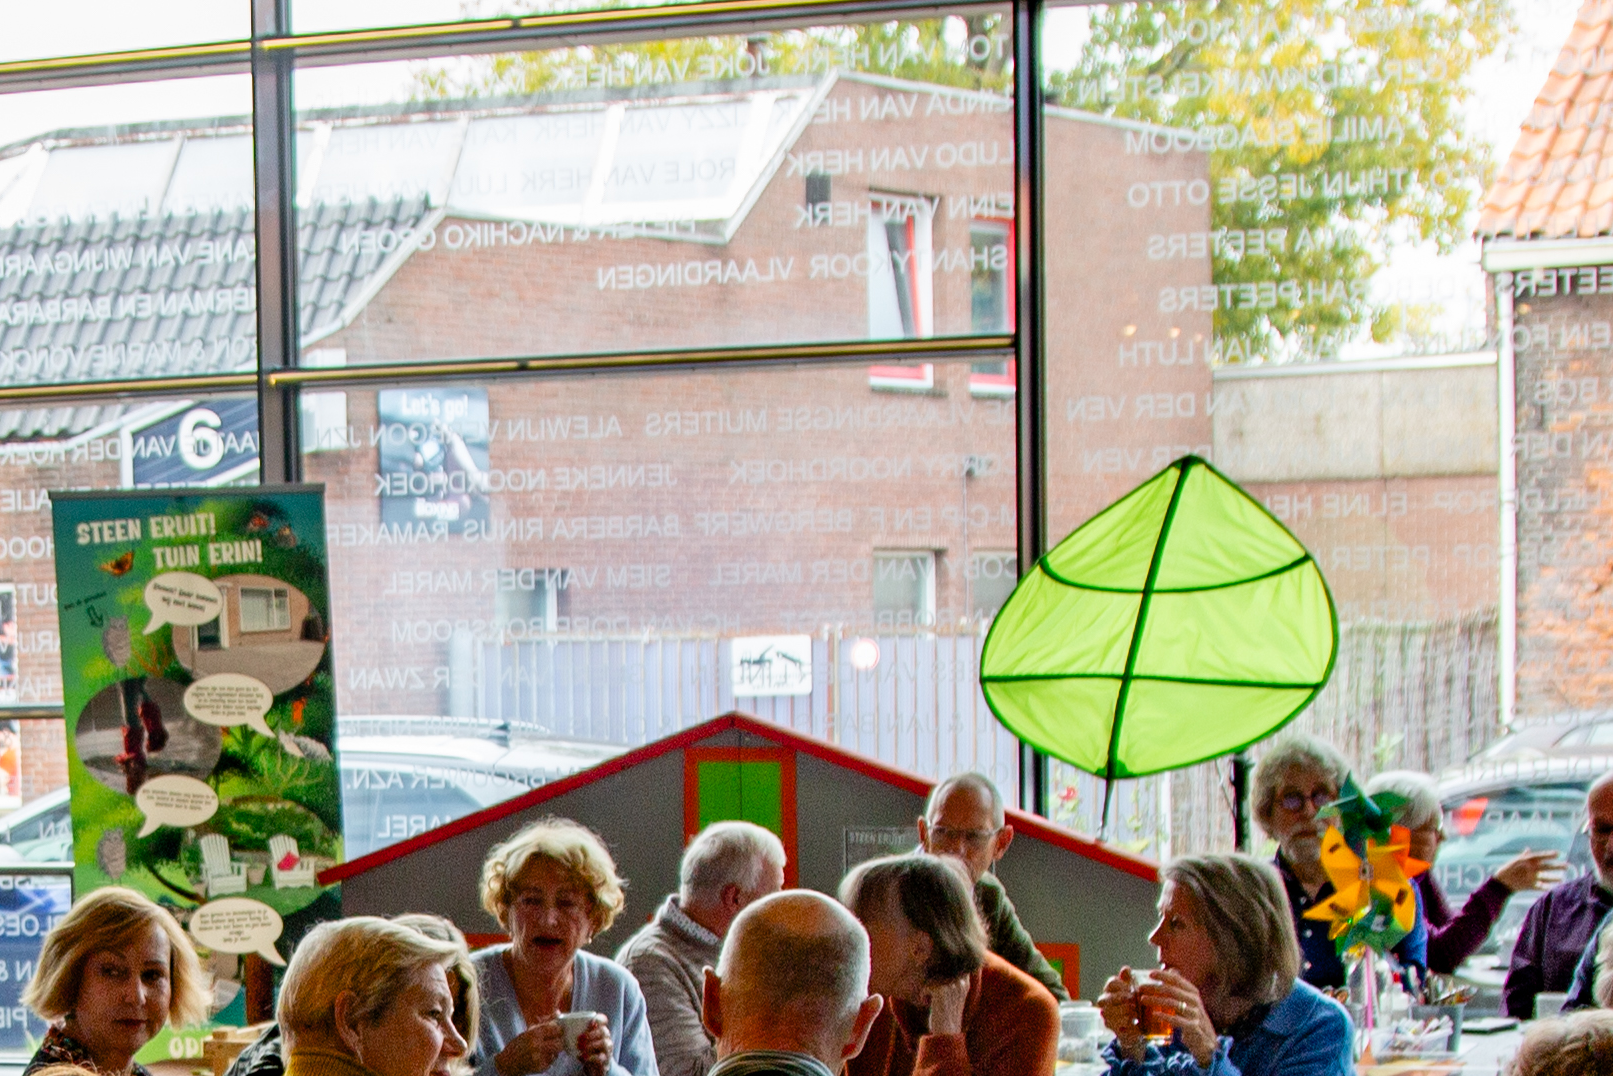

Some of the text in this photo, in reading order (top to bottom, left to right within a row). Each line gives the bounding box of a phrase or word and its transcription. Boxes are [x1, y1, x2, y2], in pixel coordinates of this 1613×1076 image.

[444, 393, 468, 423] go!
[180, 408, 224, 471] 6
[75, 513, 217, 546] STEEN ERUIT!
[152, 538, 264, 569] TUIN ERIN!
